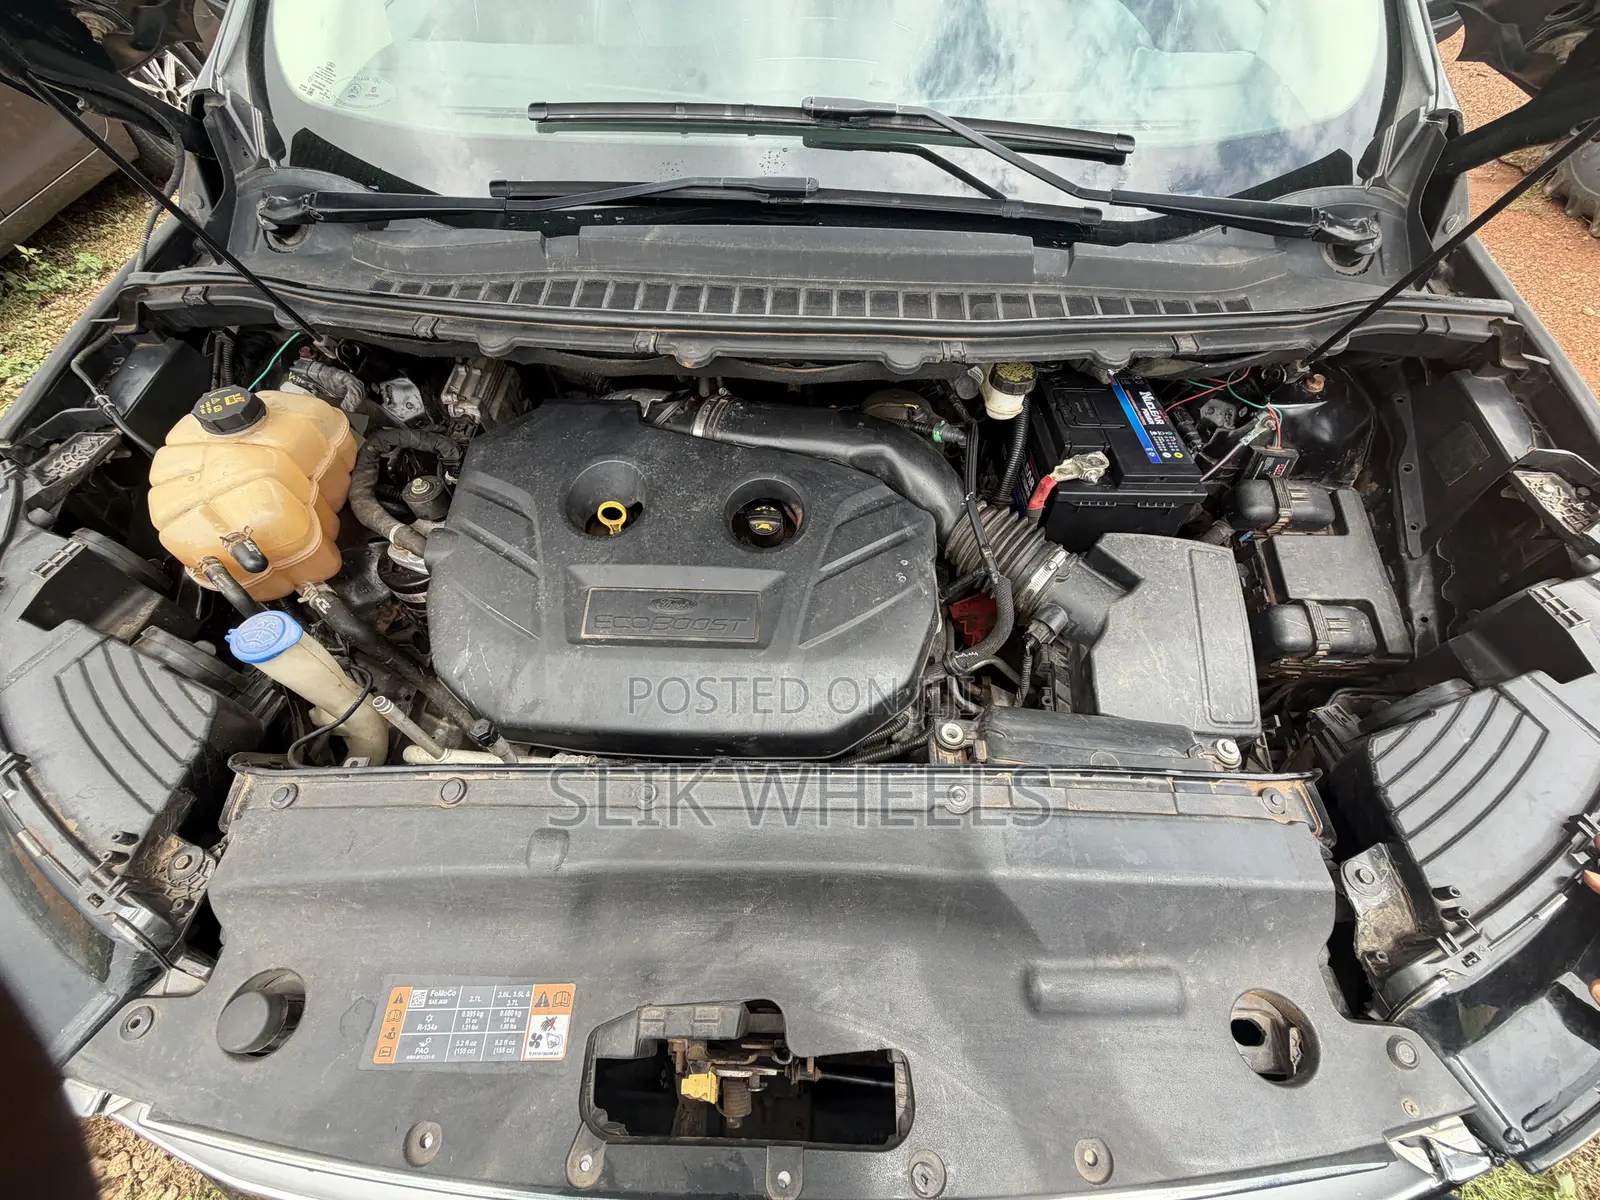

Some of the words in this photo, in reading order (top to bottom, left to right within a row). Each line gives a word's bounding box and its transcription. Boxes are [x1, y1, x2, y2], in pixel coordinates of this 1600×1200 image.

[430, 989, 457, 997] FoMoCo
[476, 1010, 484, 1018] kg
[515, 1010, 522, 1018] kg
